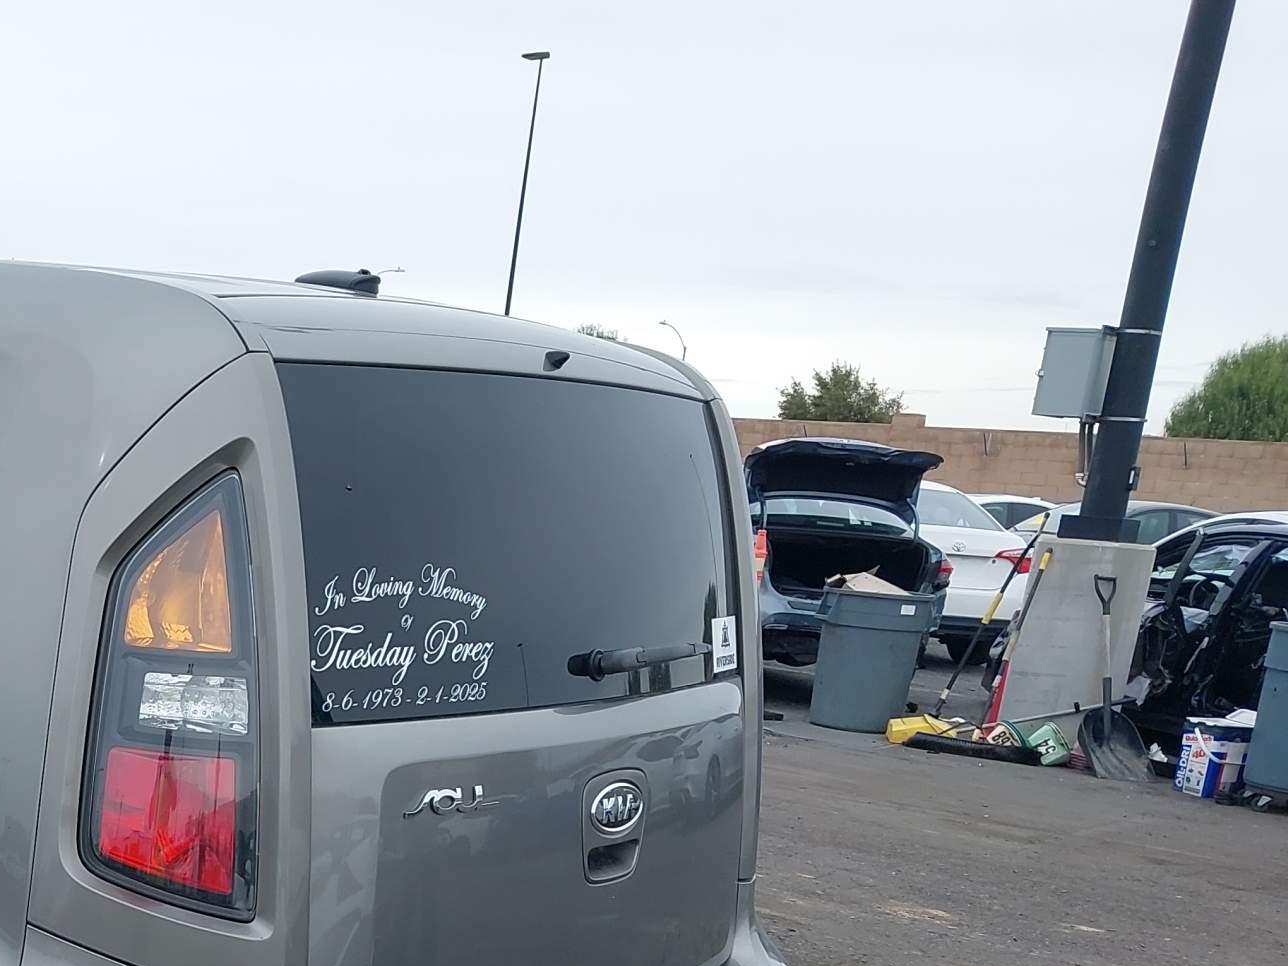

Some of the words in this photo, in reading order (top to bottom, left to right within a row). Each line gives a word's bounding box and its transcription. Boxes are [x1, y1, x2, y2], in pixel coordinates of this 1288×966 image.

[315, 575, 346, 615] In
[351, 567, 414, 609] Loving
[418, 563, 488, 620] Memory
[311, 624, 416, 686] Tuesday
[423, 619, 494, 680] Perez
[322, 687, 404, 713] 8-6-1973
[415, 681, 489, 706] 2-1-2025
